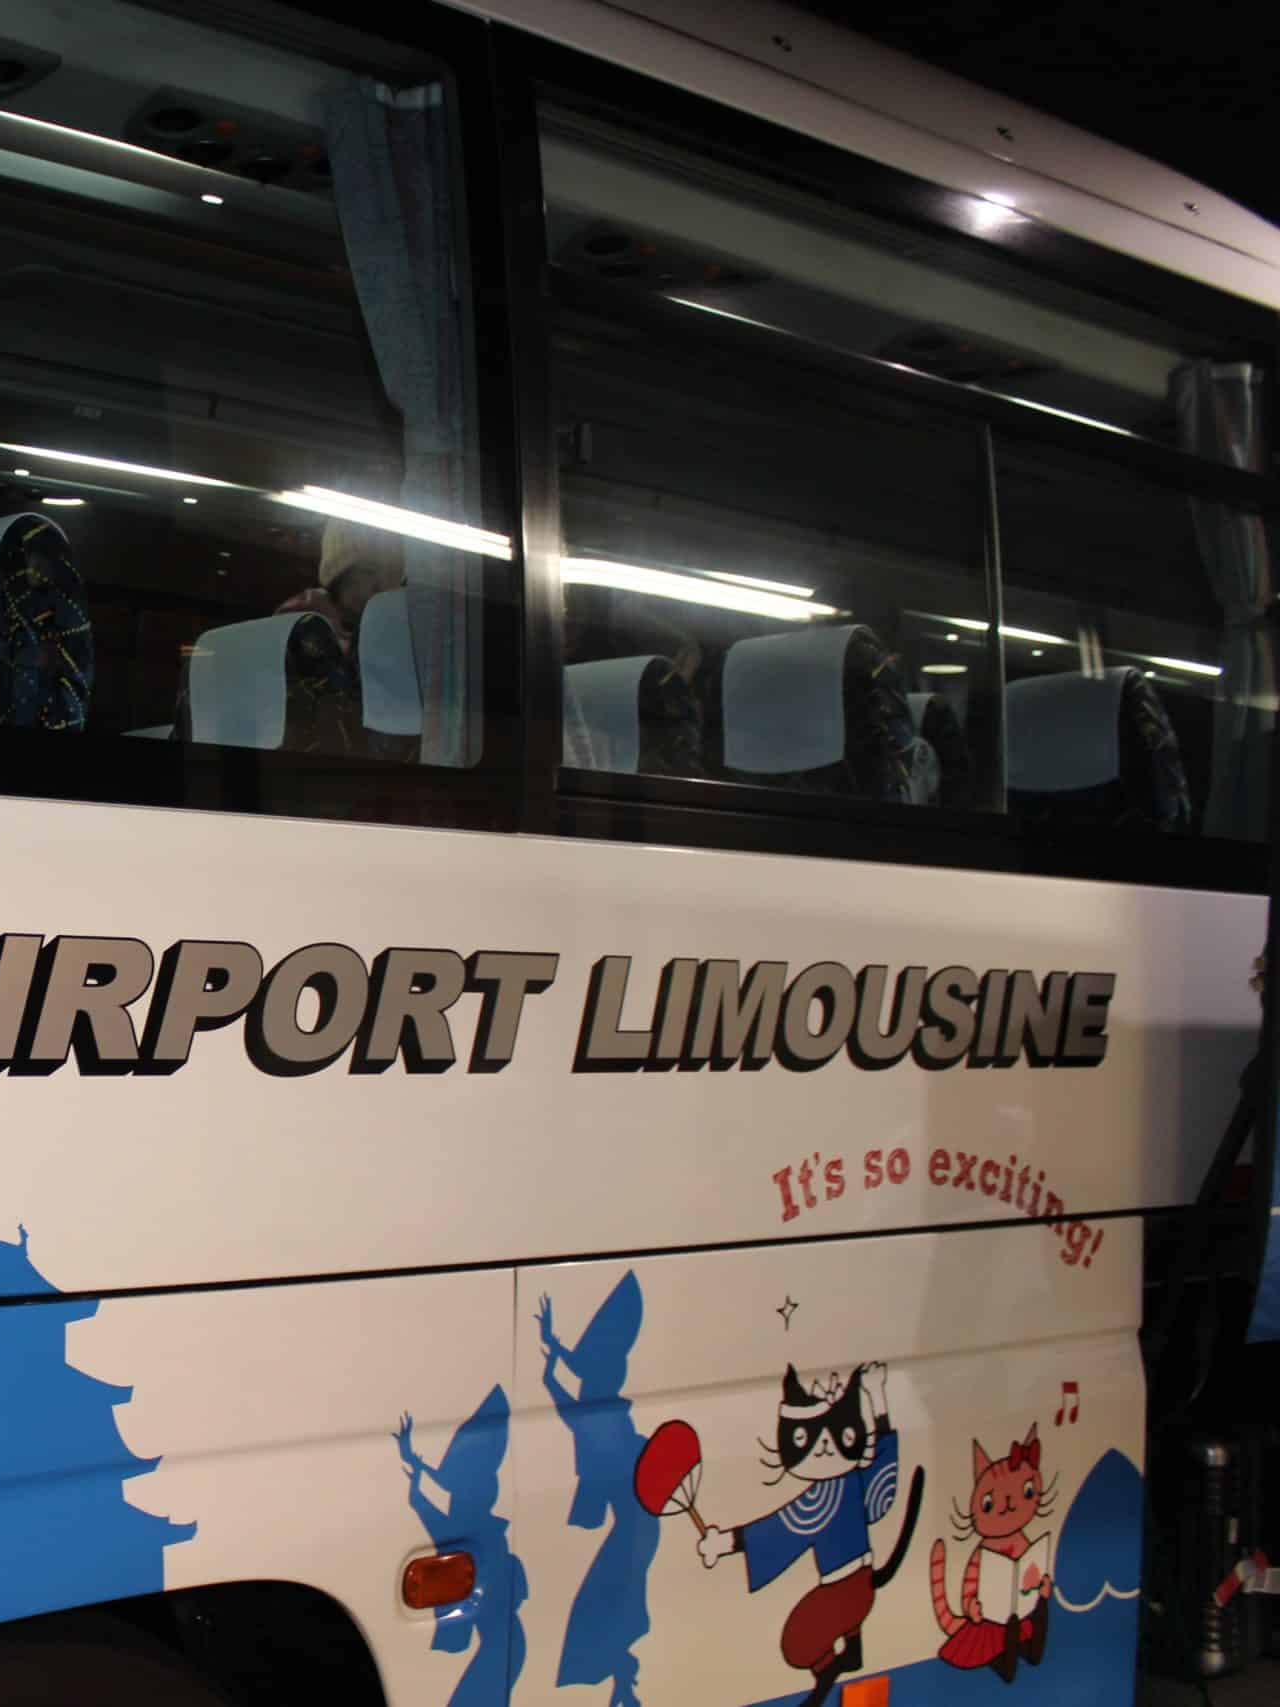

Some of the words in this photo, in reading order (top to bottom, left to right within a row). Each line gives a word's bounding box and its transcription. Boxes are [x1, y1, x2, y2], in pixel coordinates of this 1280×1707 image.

[572, 953, 1116, 1076] LIMOUSINE
[773, 1151, 846, 1224] It's
[864, 1147, 911, 1190] so
[928, 1148, 1105, 1270] exciting!
